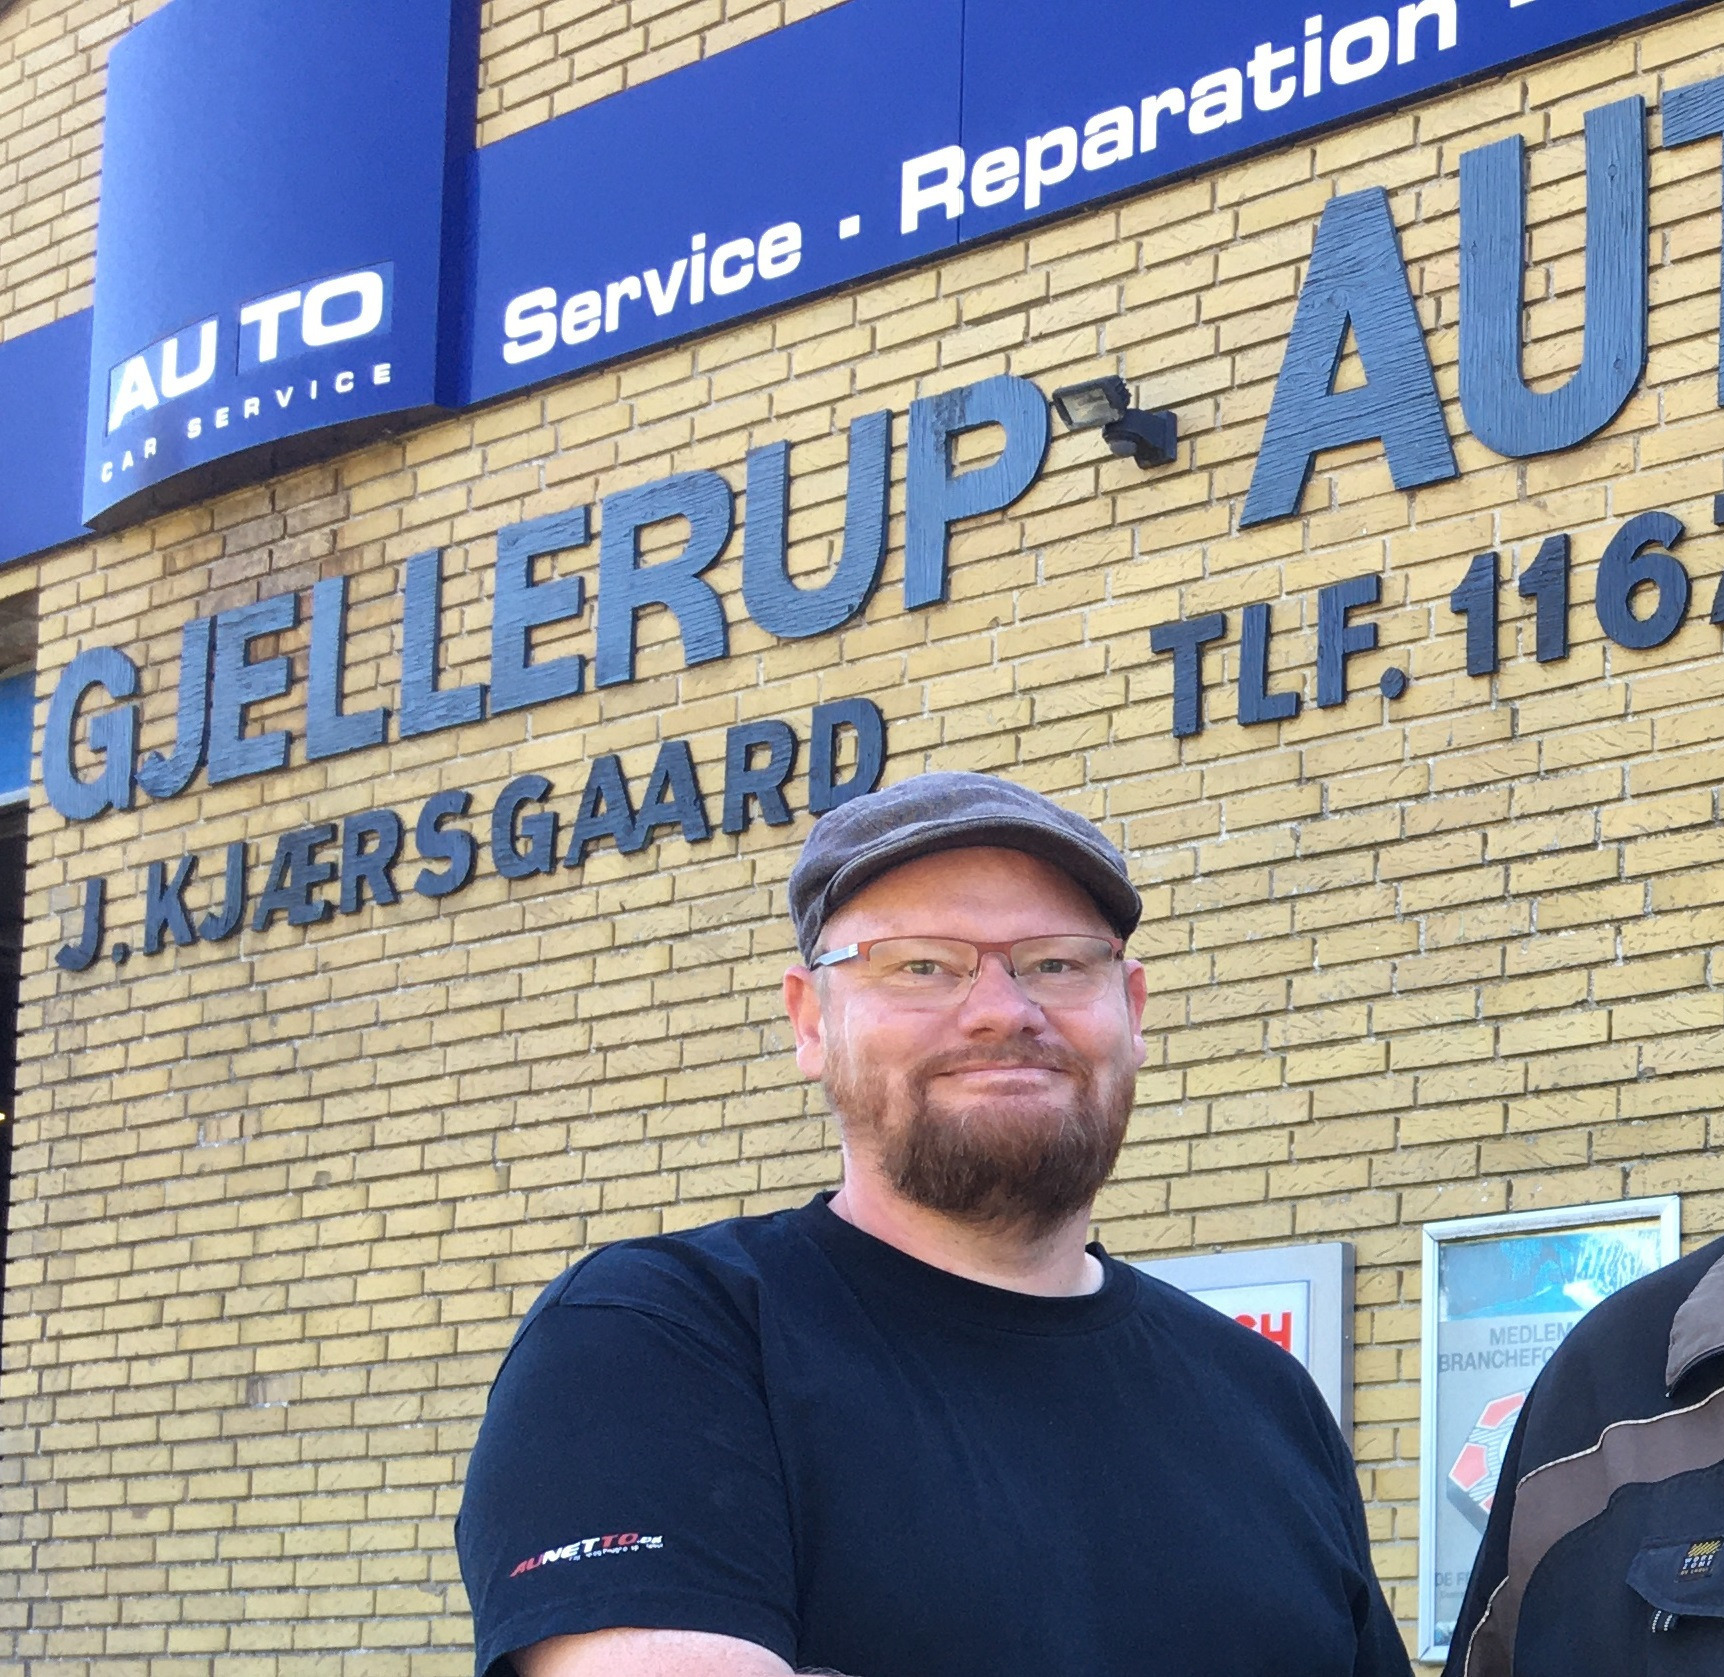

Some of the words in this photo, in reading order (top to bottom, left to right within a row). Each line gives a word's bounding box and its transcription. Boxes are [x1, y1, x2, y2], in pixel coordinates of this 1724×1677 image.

[503, 221, 803, 365] Service
[900, 0, 1458, 236] Reparation
[100, 437, 158, 483] CAR
[187, 362, 392, 440] SERVICE
[42, 374, 1052, 821] GJELLERUP
[1150, 573, 1409, 738] TLF.
[55, 877, 128, 972] J.
[143, 697, 886, 956] KJÆRSGAARD
